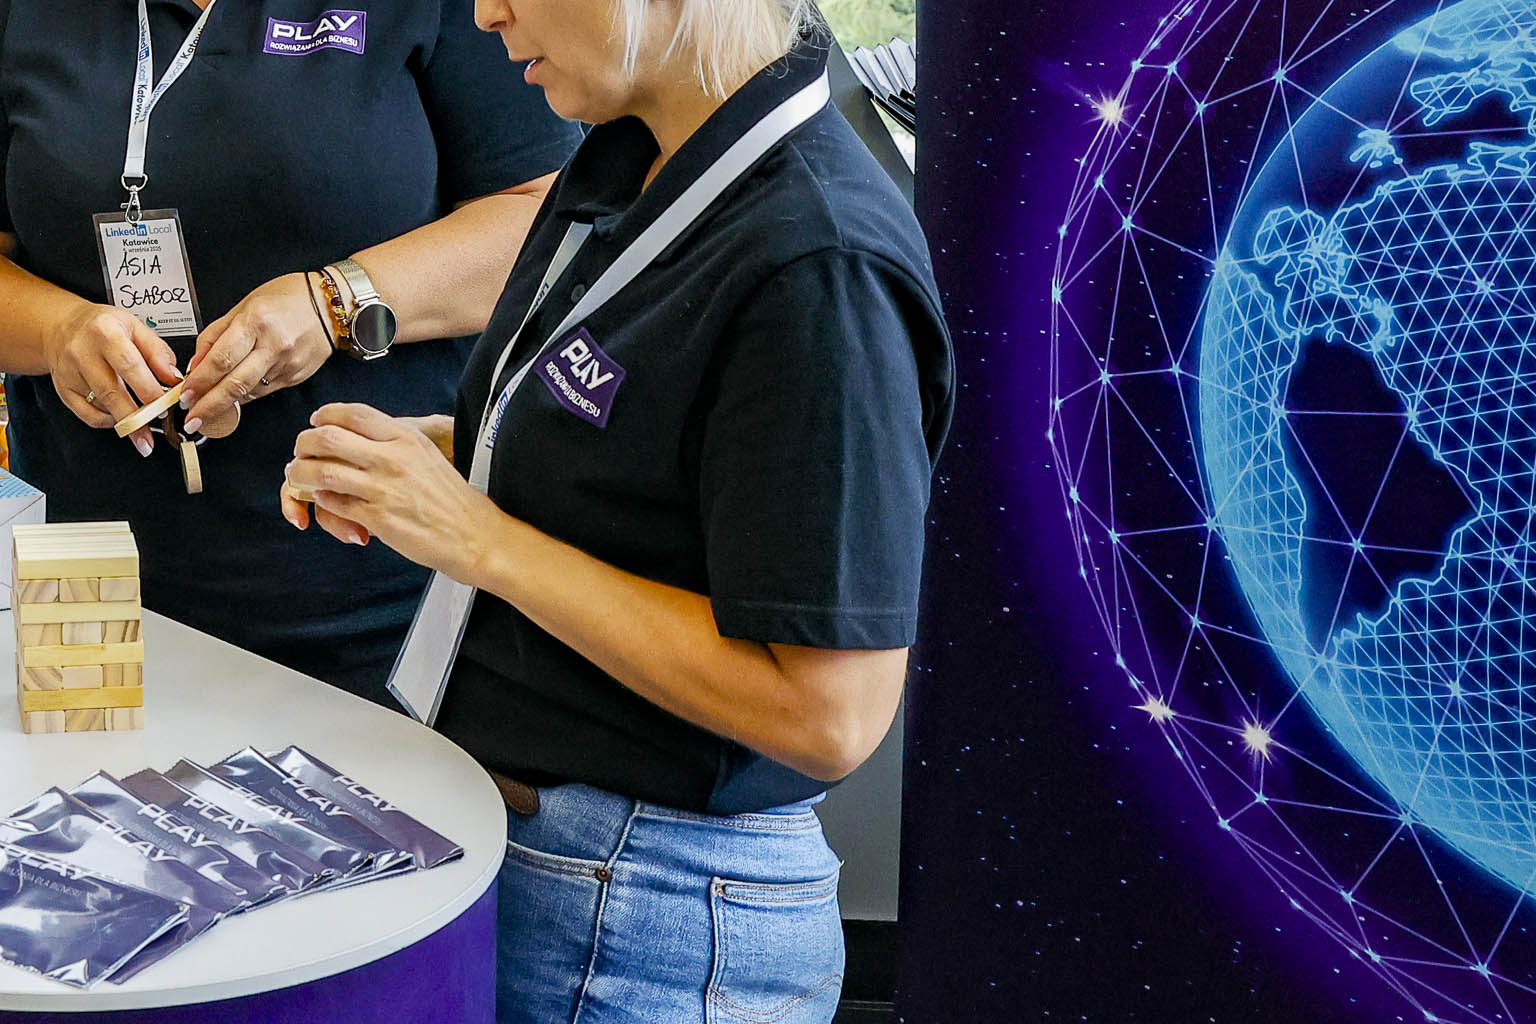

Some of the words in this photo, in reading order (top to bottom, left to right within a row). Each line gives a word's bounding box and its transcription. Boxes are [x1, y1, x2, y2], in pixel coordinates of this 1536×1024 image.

[272, 15, 358, 41] PLAY
[328, 35, 359, 47] BIZNESU
[122, 237, 159, 247] Katowice
[115, 251, 162, 279] ASIA
[559, 337, 615, 390] PLAY
[183, 796, 264, 834] PLAY
